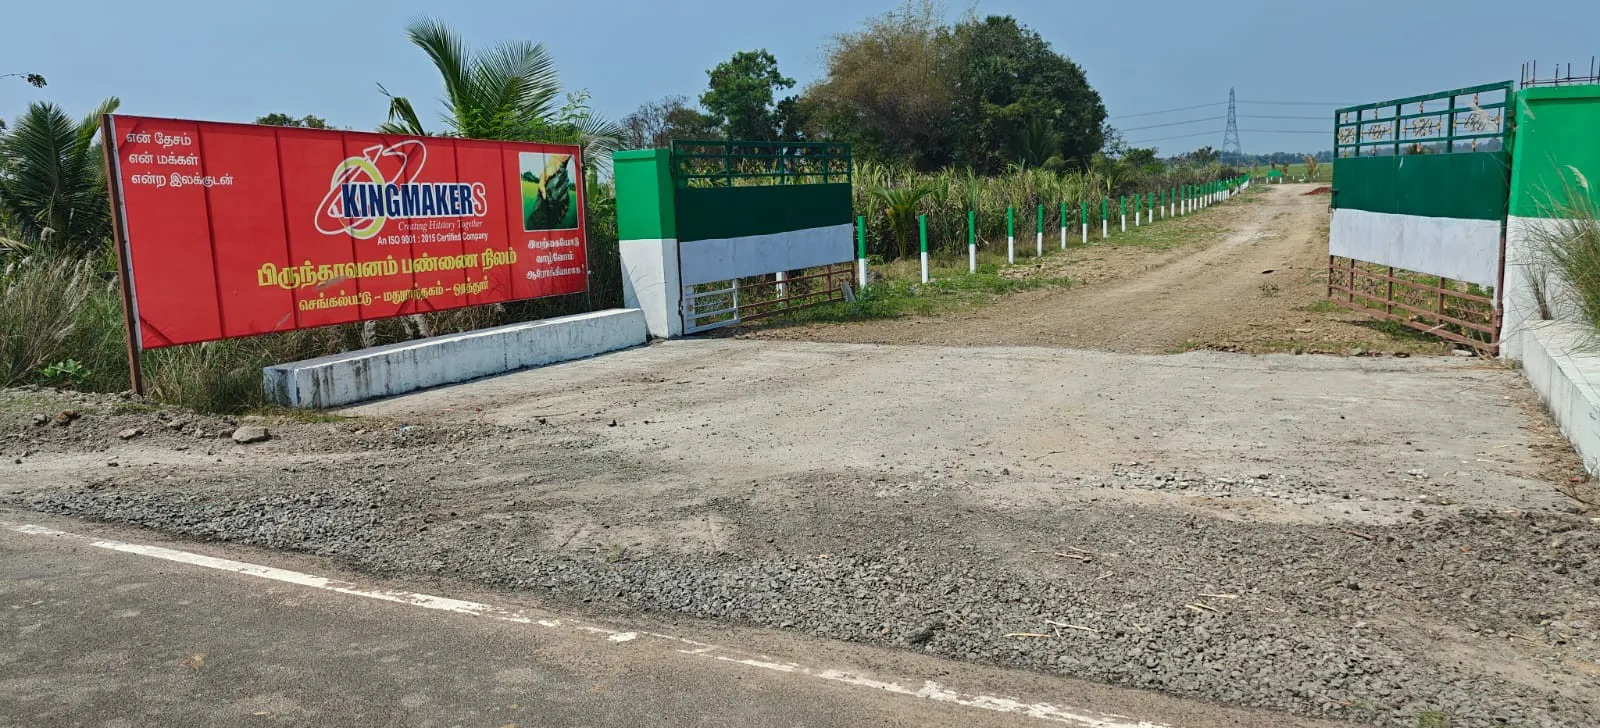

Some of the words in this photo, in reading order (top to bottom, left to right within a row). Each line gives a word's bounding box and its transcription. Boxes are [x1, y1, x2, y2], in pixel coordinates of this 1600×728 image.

[126, 131, 151, 145] என்
[154, 132, 191, 149] தேசம்
[128, 151, 153, 164] என்
[157, 153, 198, 166] மக்கள்
[131, 172, 166, 188] என்ற
[169, 173, 234, 188] இலக்குடன்
[341, 182, 487, 219] KINGMAKERS
[398, 221, 428, 232] Creating
[457, 218, 483, 231] Together
[377, 236, 387, 245] An
[388, 235, 400, 245] ISO
[401, 234, 416, 244] 9001
[421, 233, 436, 243] 2015
[437, 232, 461, 243] Certified
[462, 231, 488, 242] Company
[257, 254, 398, 289] பிருந்தாவனம்
[402, 252, 478, 274] பண்ணை
[481, 246, 517, 271] நிலம்
[299, 289, 372, 311] செங்கல்பட்டு
